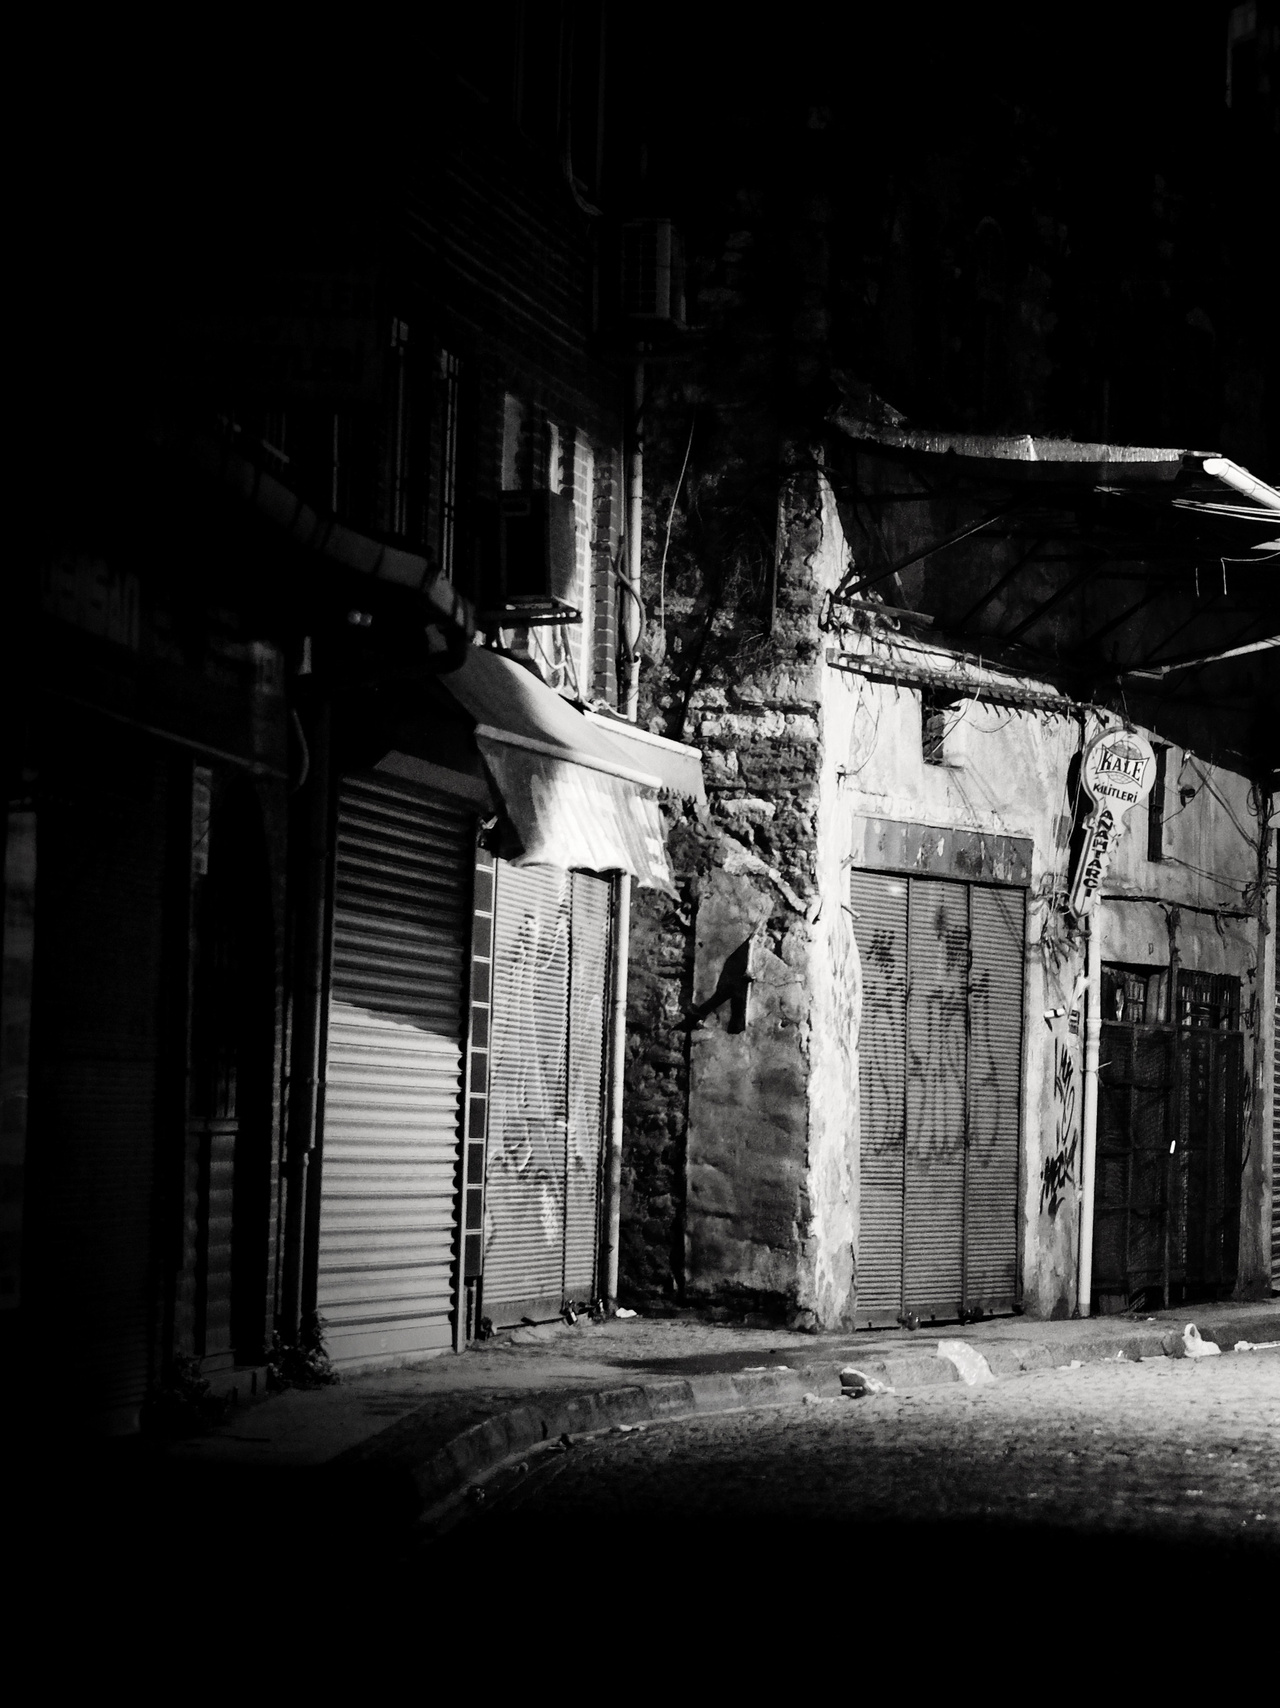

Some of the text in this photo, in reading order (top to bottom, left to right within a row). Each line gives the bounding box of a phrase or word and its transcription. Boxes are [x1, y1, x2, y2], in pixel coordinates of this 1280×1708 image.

[1101, 753, 1145, 782] KALE
[1092, 782, 1139, 804] KİLİTLERİ
[1083, 809, 1114, 898] ANAHTARCI
